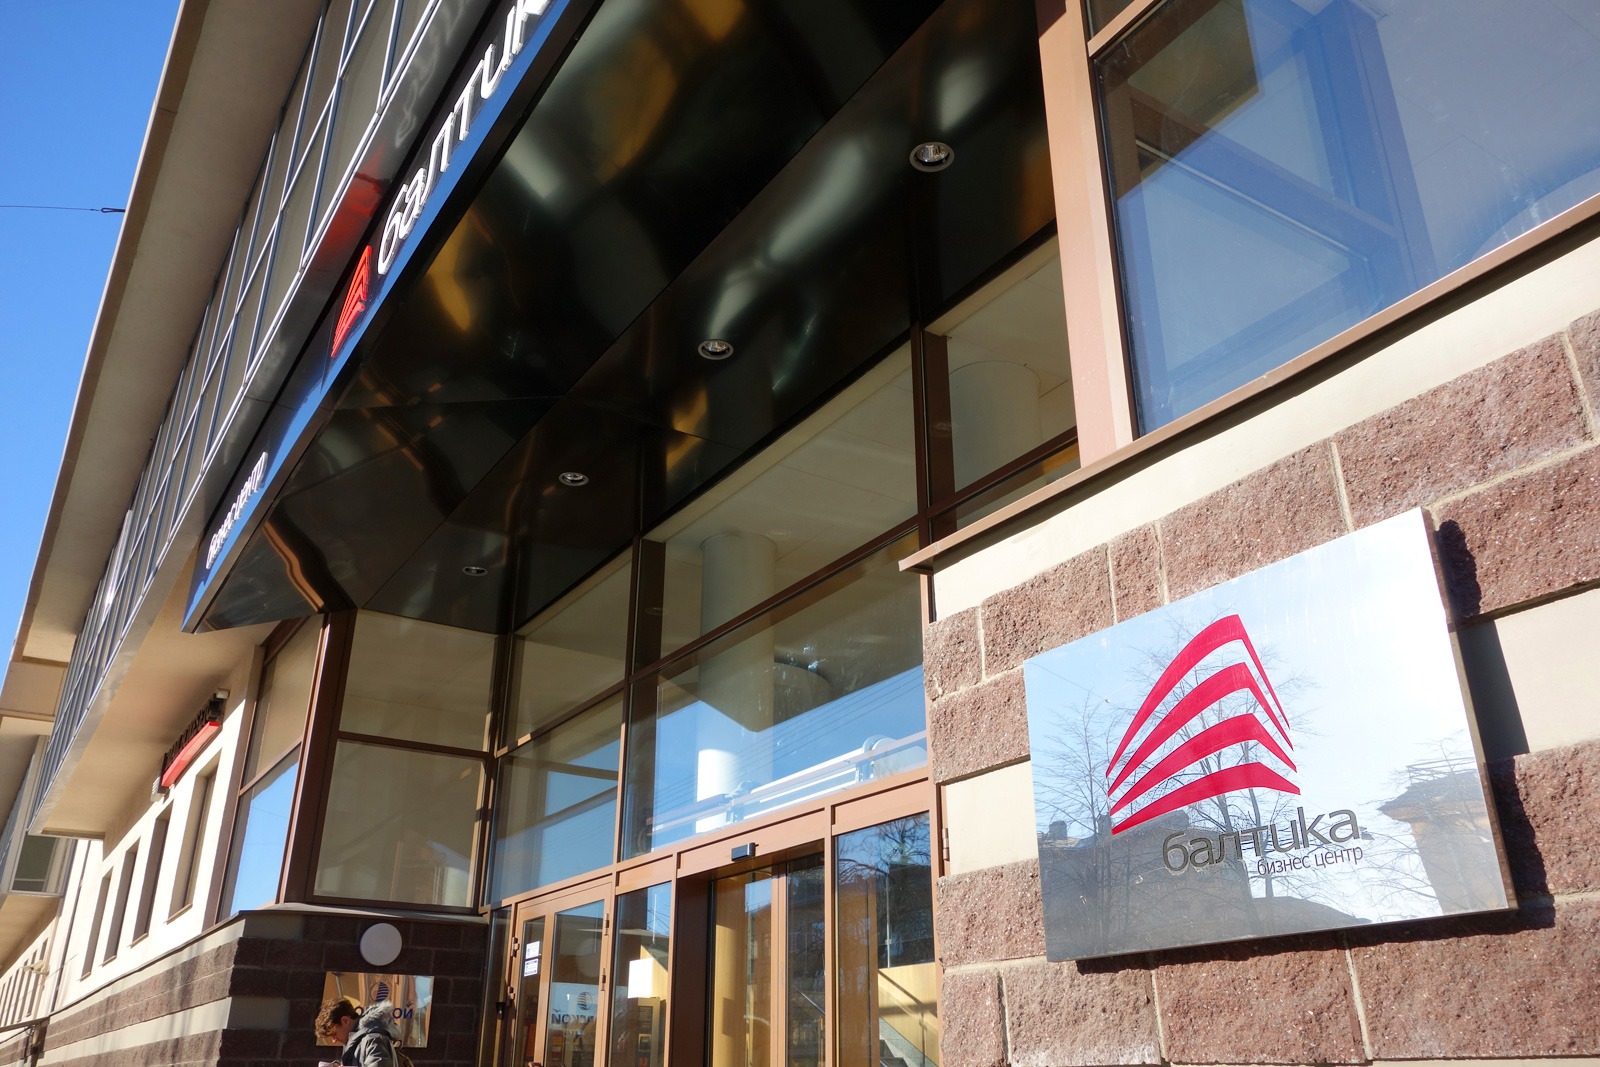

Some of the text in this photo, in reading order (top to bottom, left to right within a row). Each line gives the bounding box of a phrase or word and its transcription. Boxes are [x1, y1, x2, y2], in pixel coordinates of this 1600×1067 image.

[1162, 806, 1362, 873] балтика
[1257, 846, 1364, 876] бизнес центр
